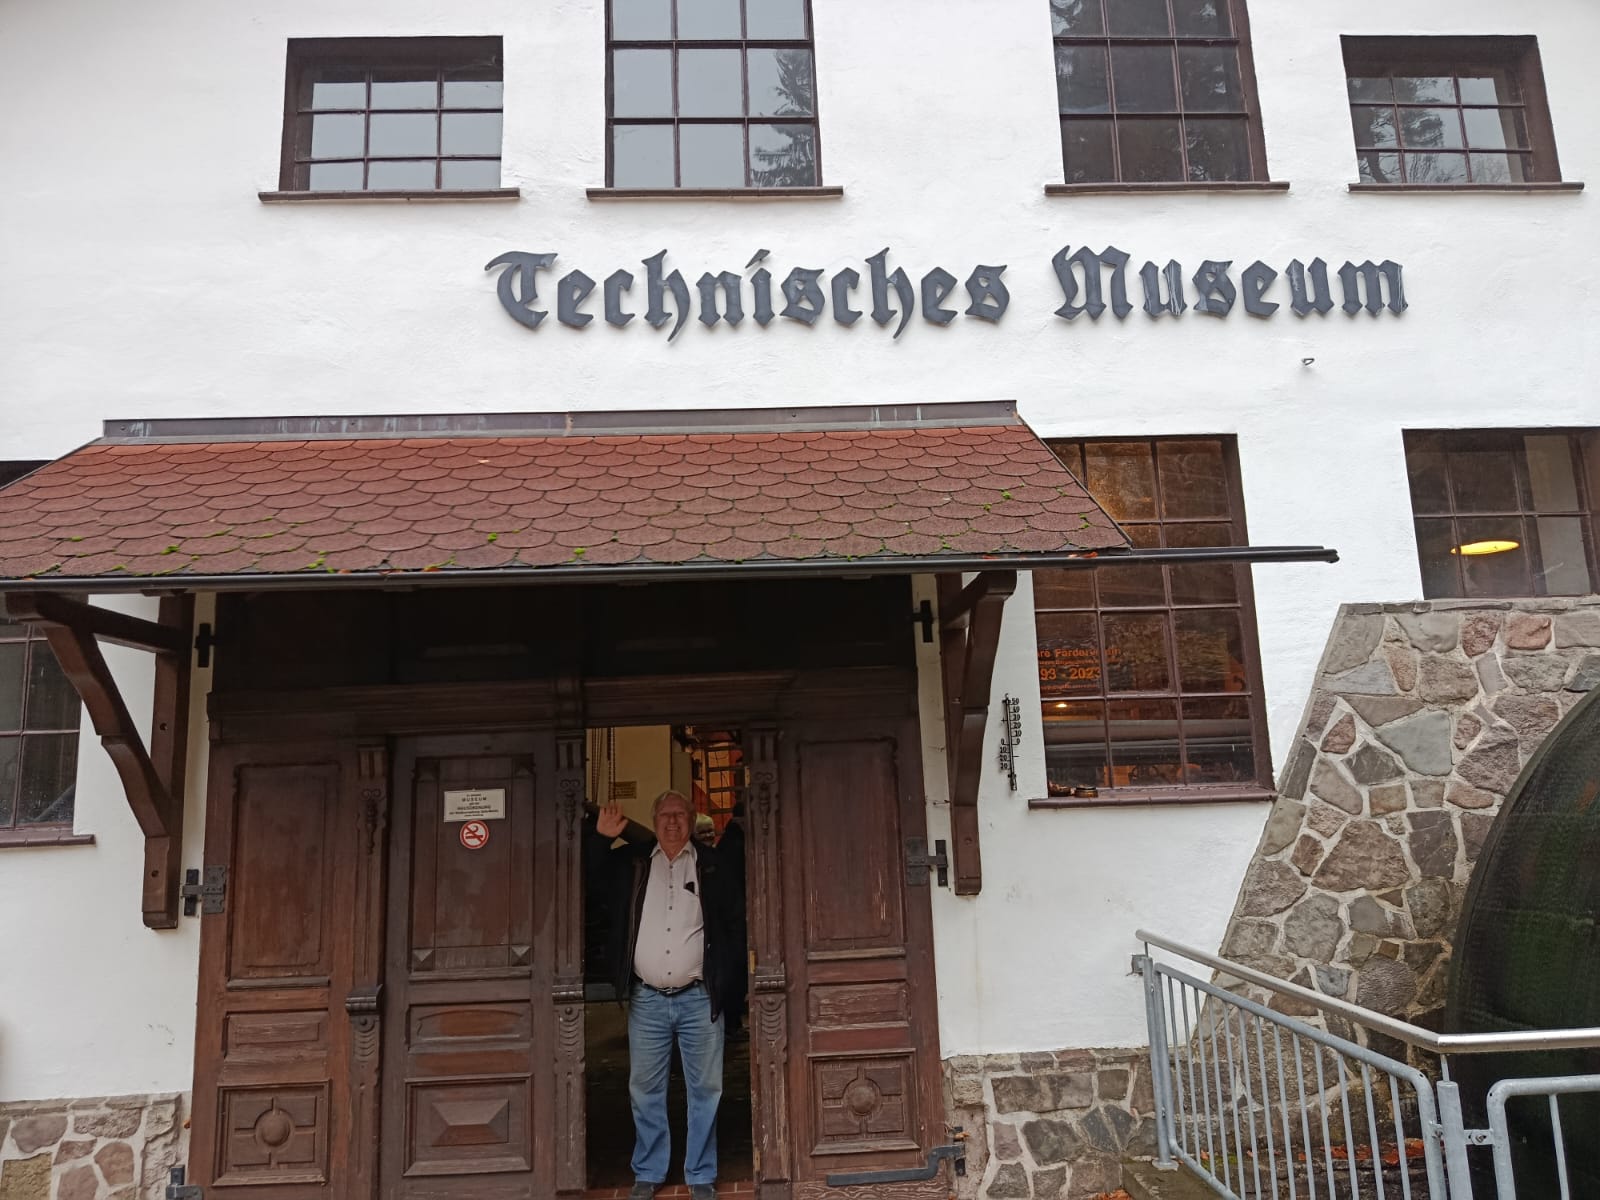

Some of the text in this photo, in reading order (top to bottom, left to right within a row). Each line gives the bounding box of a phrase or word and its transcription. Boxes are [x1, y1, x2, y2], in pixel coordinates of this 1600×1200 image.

[484, 245, 1409, 342] Technisches Museum
[1069, 667, 1101, 679] 2023
